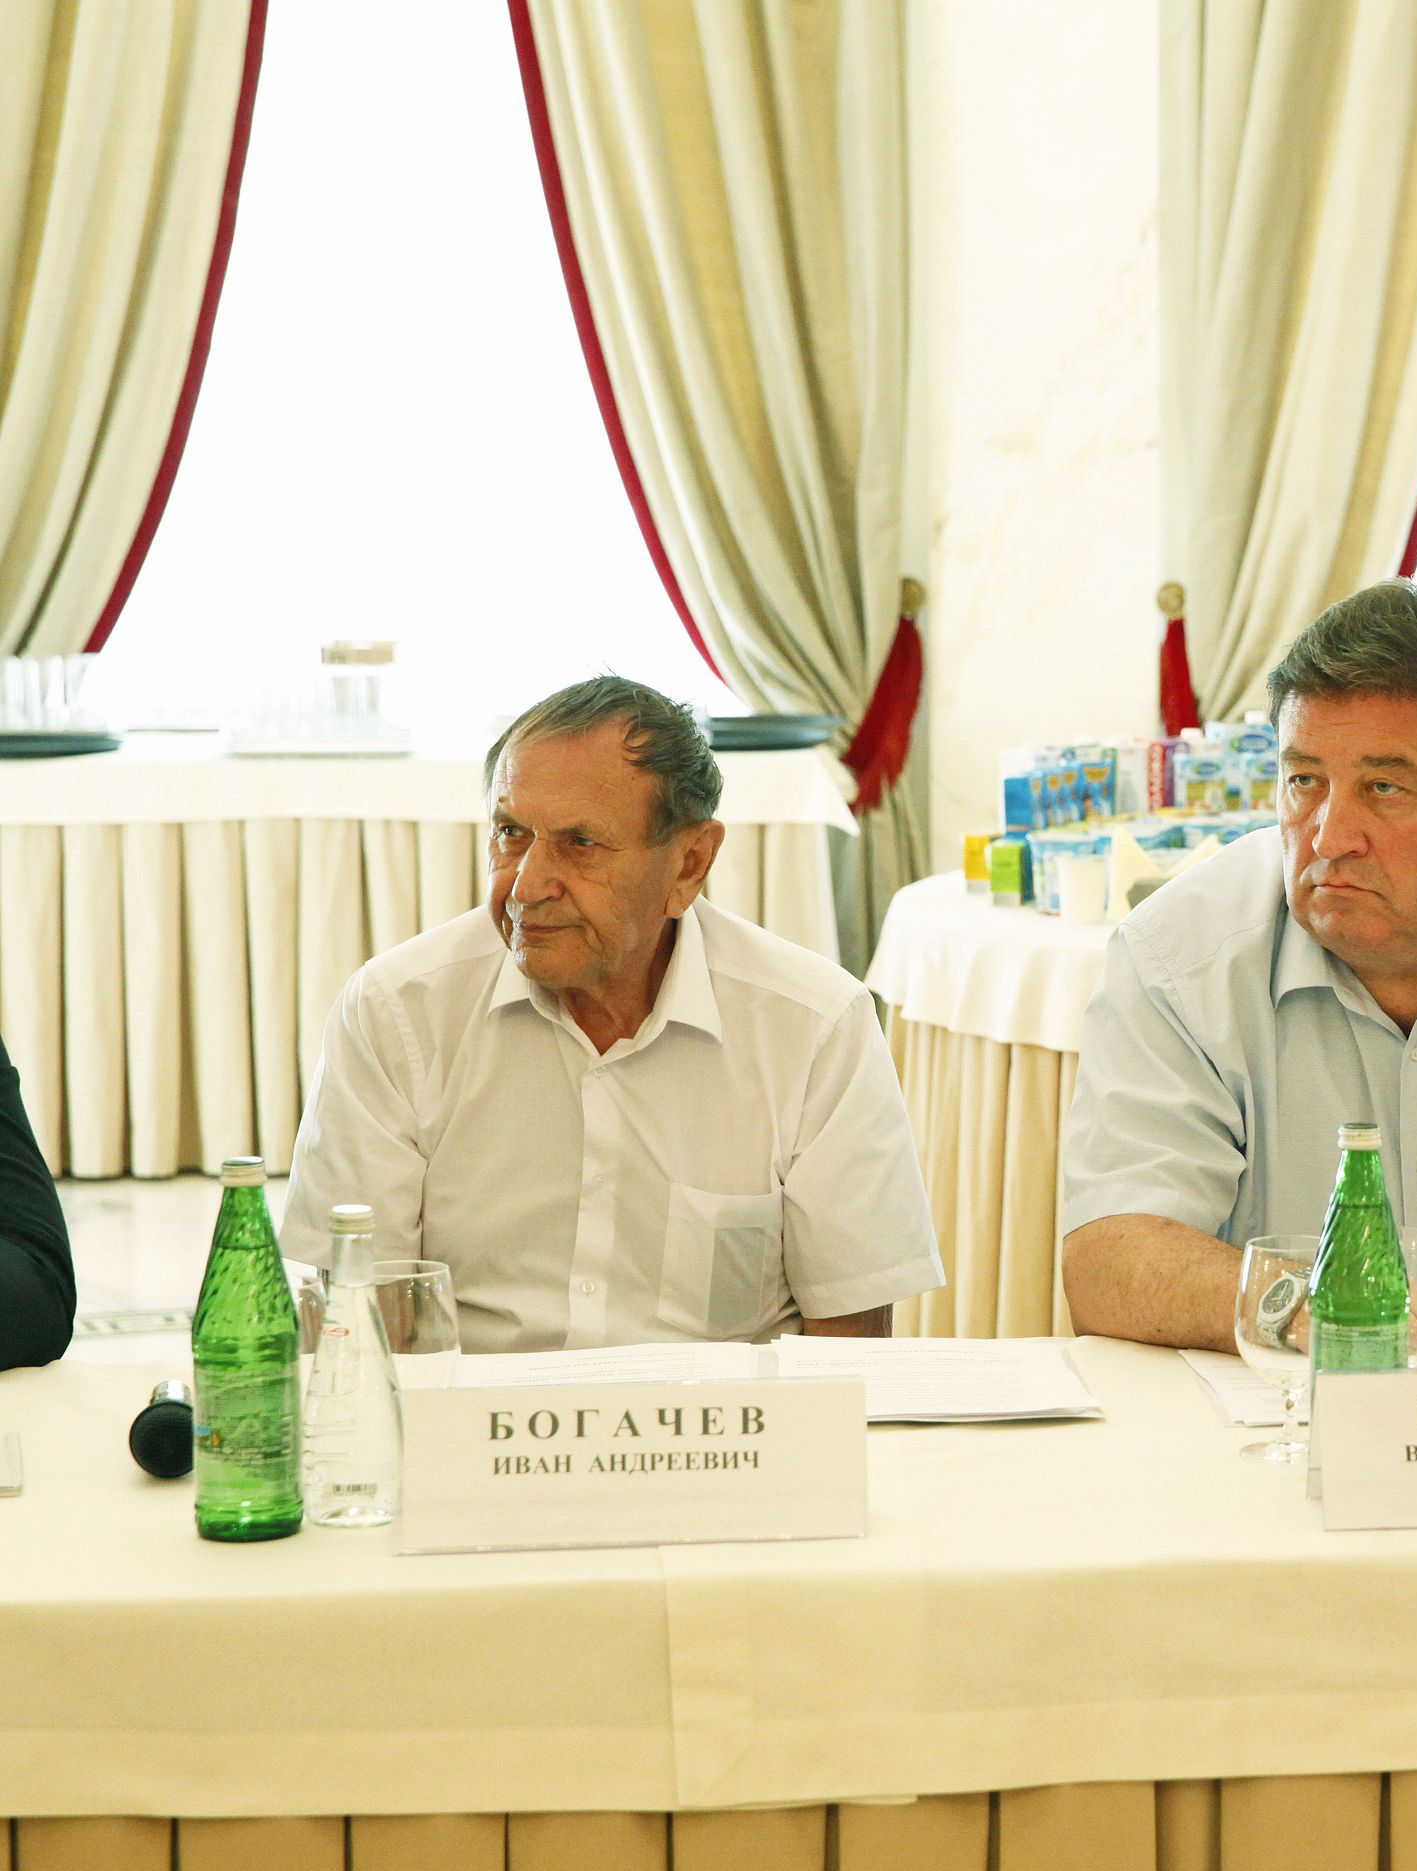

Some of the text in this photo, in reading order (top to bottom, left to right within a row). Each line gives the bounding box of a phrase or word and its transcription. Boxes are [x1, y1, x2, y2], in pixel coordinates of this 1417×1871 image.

[488, 1406, 766, 1441] БОГАЧЕВ
[493, 1450, 760, 1476] ИВАН АНДРЕЕВИЧ
